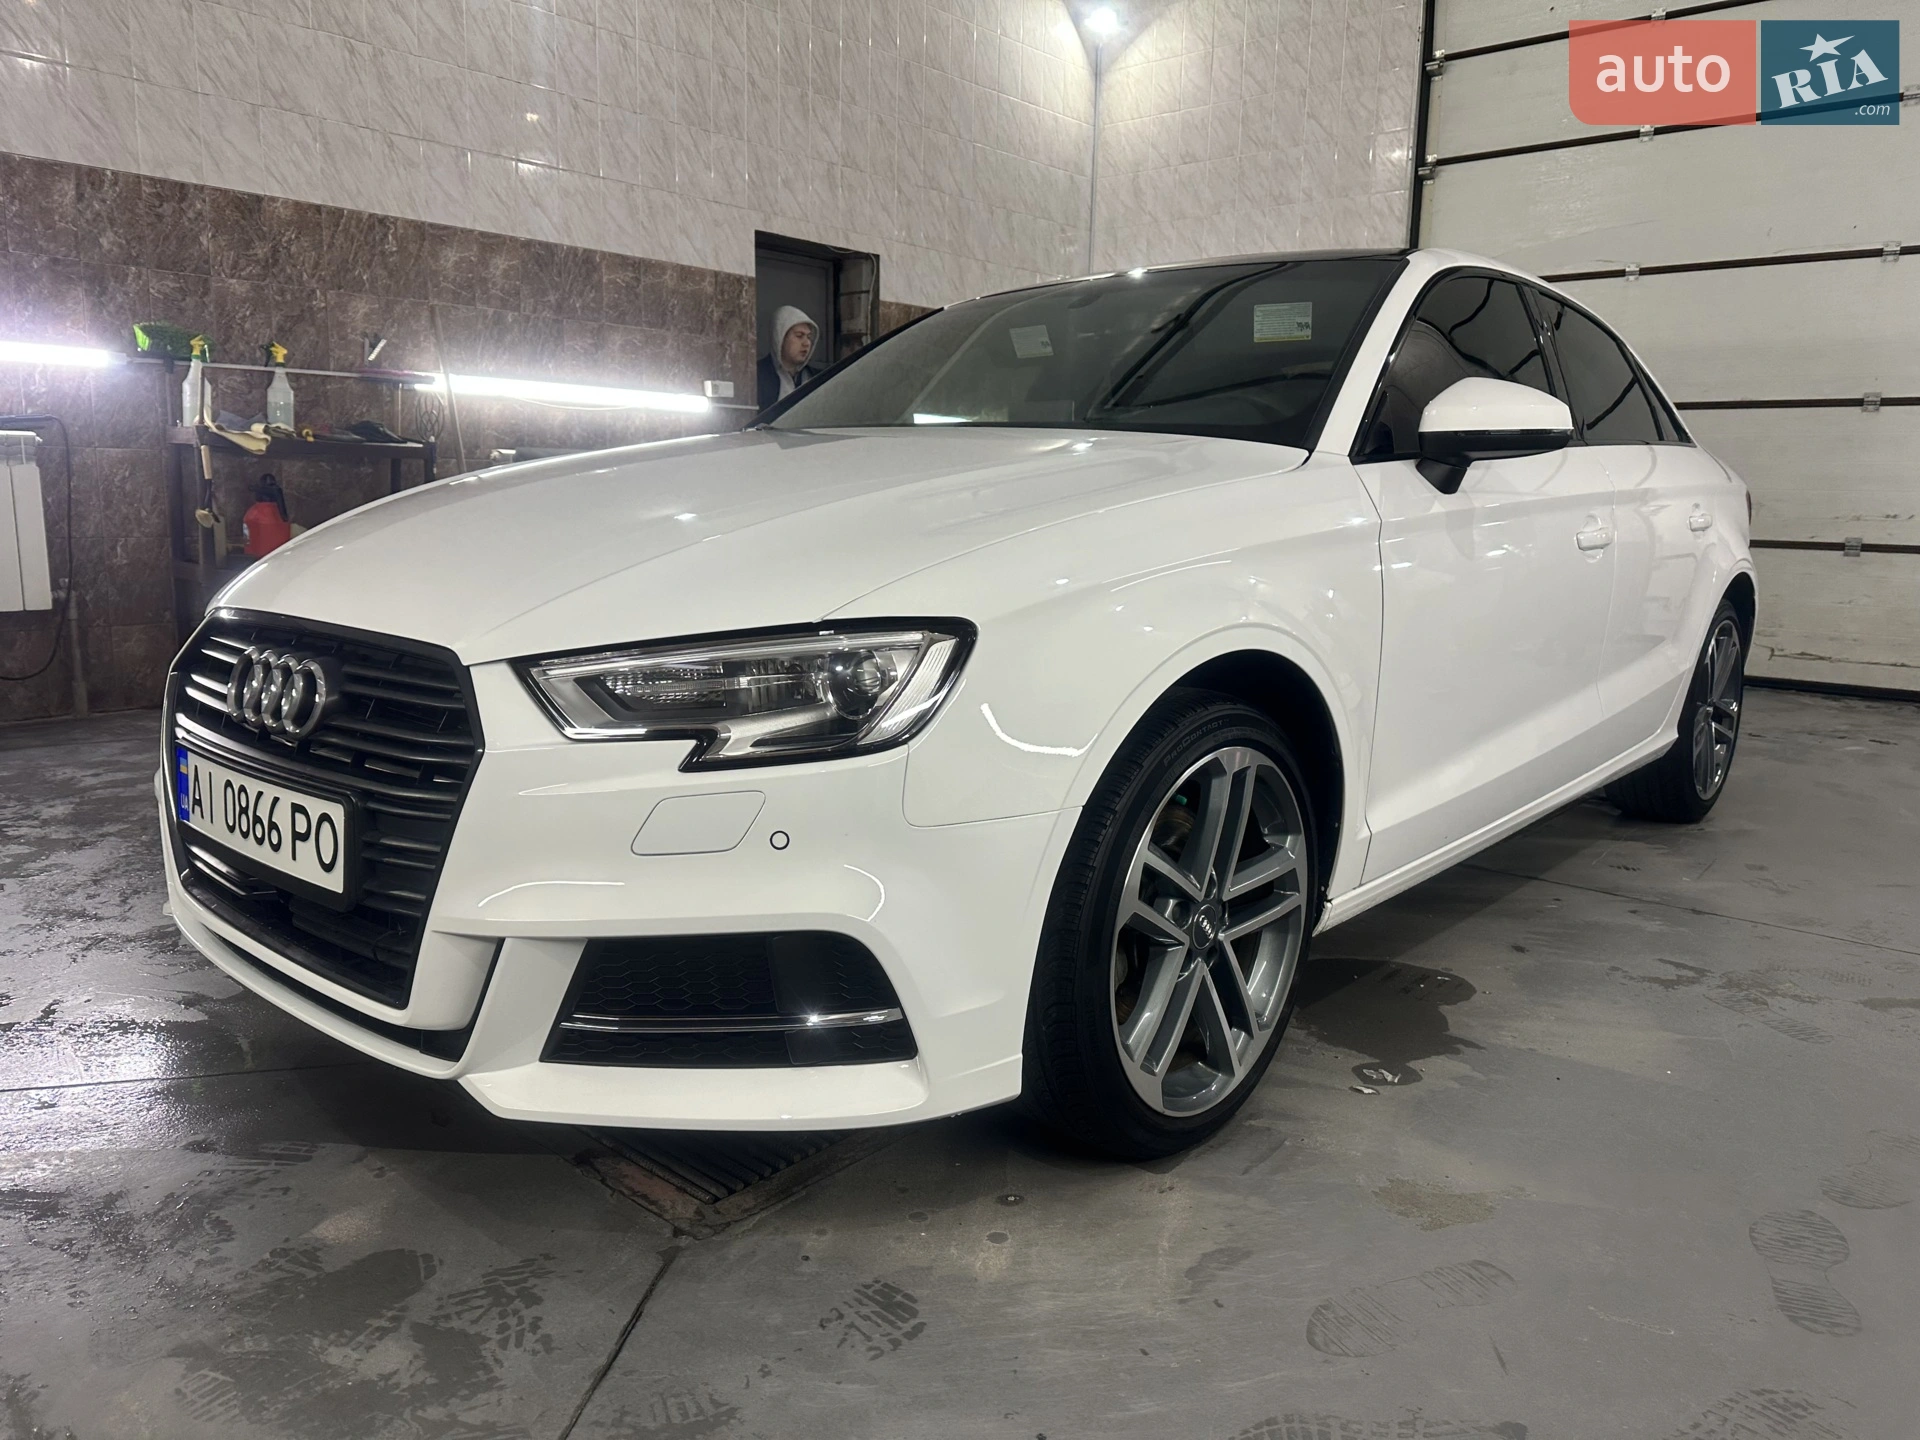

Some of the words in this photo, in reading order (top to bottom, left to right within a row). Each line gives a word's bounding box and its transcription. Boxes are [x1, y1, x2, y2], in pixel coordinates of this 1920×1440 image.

[180, 792, 189, 811] UA
[191, 764, 214, 825] AI
[223, 779, 283, 853] 0866
[290, 801, 339, 874] PO
